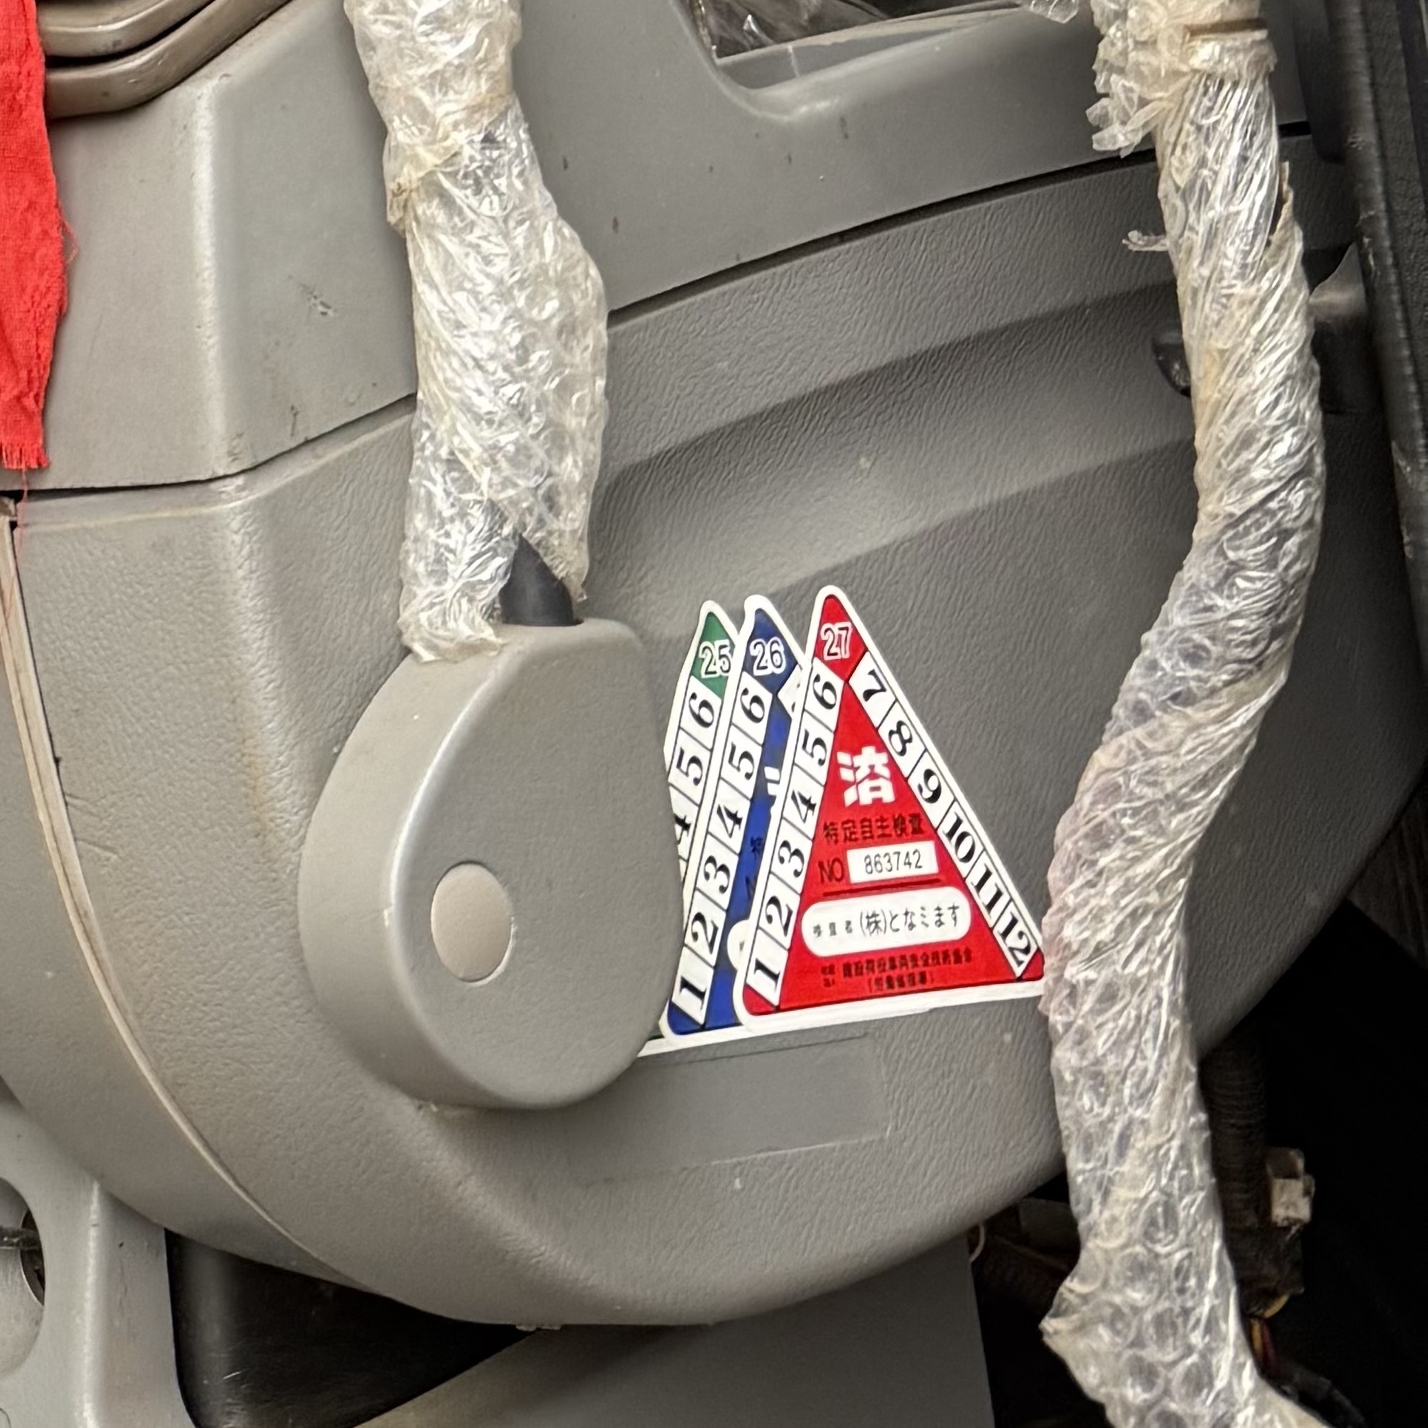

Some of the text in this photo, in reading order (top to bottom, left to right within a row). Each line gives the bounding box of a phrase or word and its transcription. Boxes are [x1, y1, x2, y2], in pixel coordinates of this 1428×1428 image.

[698, 639, 732, 678] 25
[750, 635, 786, 677] 26
[820, 621, 853, 662] 27
[812, 673, 838, 710] 6
[862, 669, 887, 702] 7
[688, 690, 717, 730] 6
[741, 687, 767, 724] 6
[802, 730, 827, 767] 5
[887, 720, 914, 755] 8
[676, 745, 703, 786] 5
[728, 742, 755, 781] 5
[917, 768, 942, 804] 9
[716, 804, 743, 838] 4
[790, 789, 816, 823] 4
[822, 813, 926, 845] 特定自主検査
[942, 816, 976, 864] 10
[703, 855, 731, 894] 3
[778, 841, 805, 878] 3
[817, 849, 923, 884] NO 863742
[968, 866, 1003, 917] 11
[691, 910, 720, 948] 2
[765, 895, 794, 934] 2
[999, 916, 1035, 968] 12
[753, 956, 782, 986] 1
[679, 985, 708, 1015] 1
